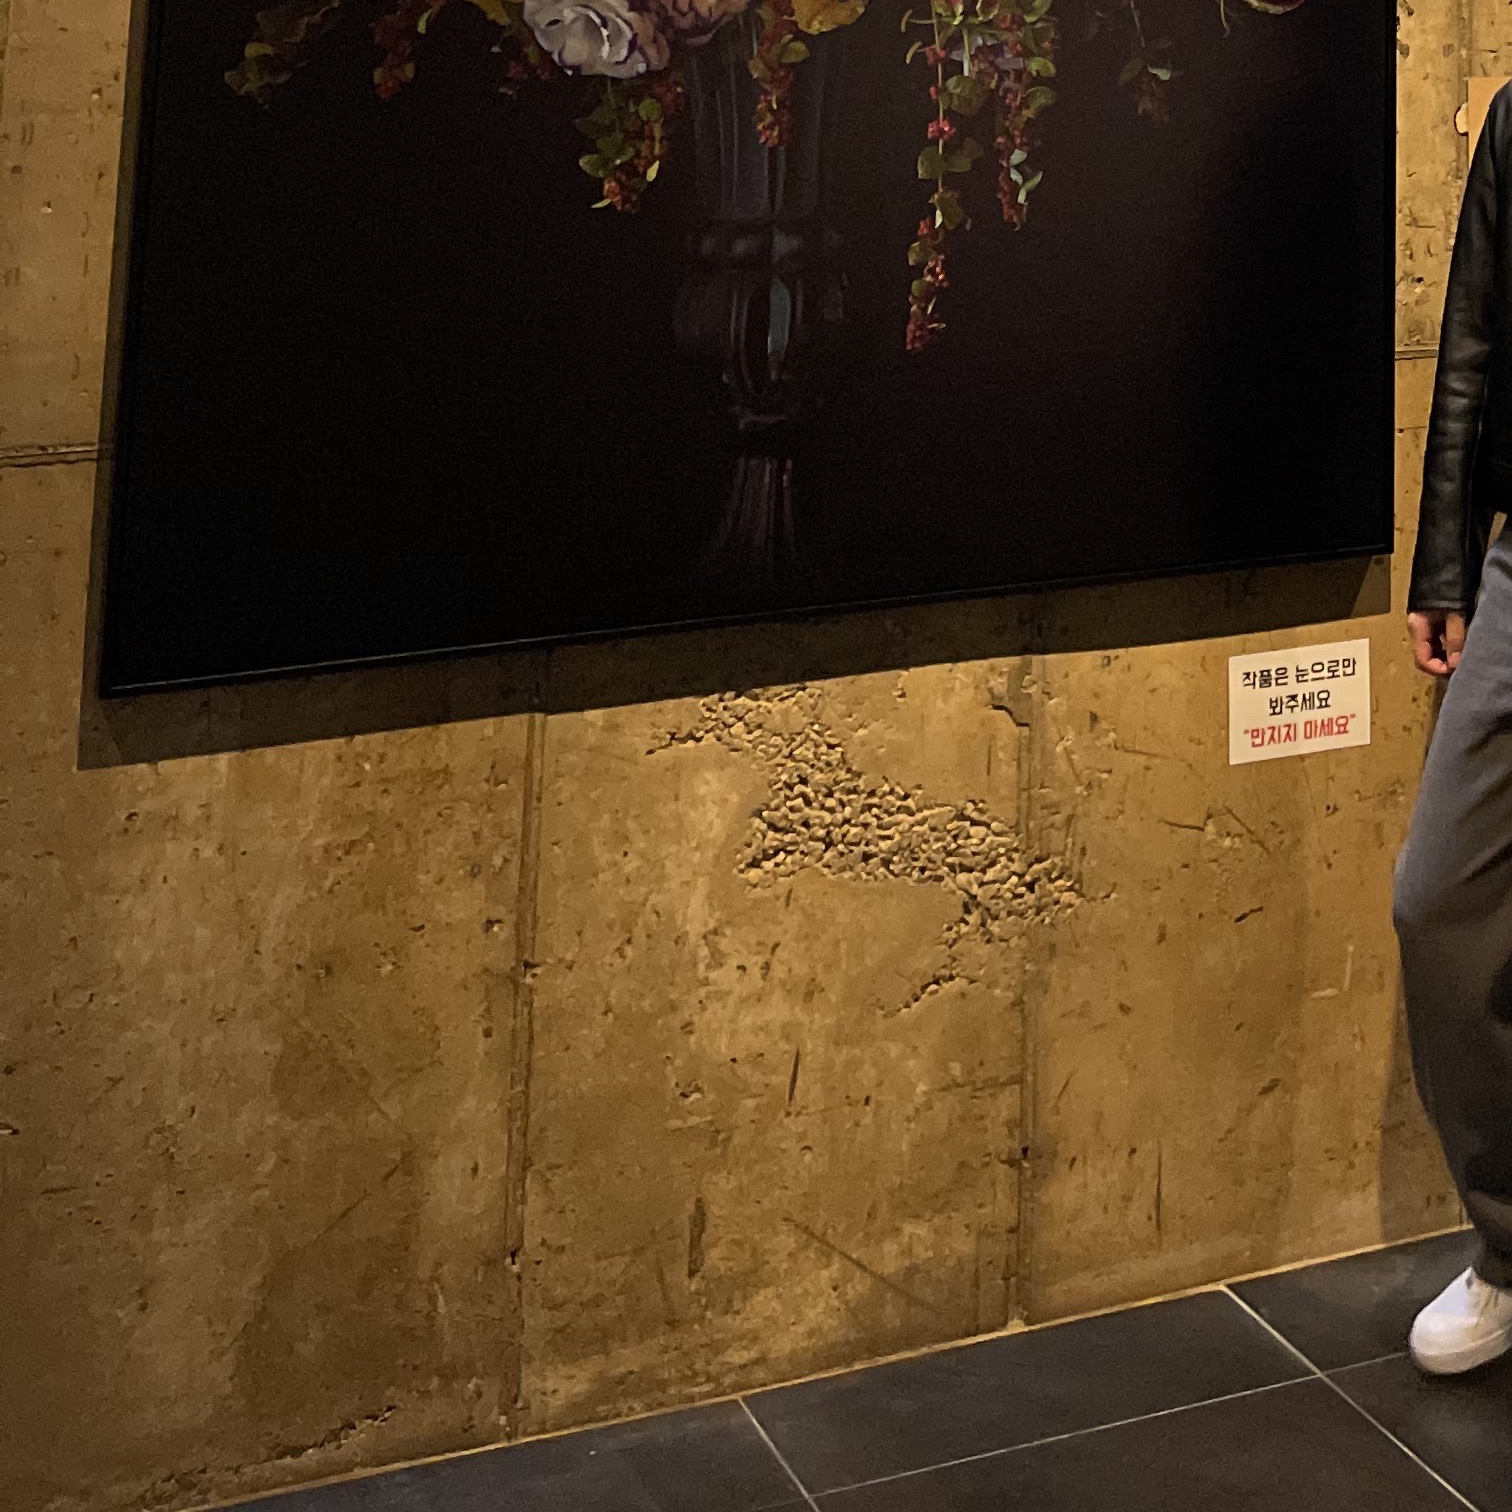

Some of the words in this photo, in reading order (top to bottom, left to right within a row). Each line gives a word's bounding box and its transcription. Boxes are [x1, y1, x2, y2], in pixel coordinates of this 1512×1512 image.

[1242, 666, 1288, 689] 작품은
[1295, 657, 1356, 684] 눈으로만
[1269, 689, 1331, 716] 봐주세요
[1243, 722, 1297, 748] "만지지
[1303, 713, 1356, 740] 마세요"
